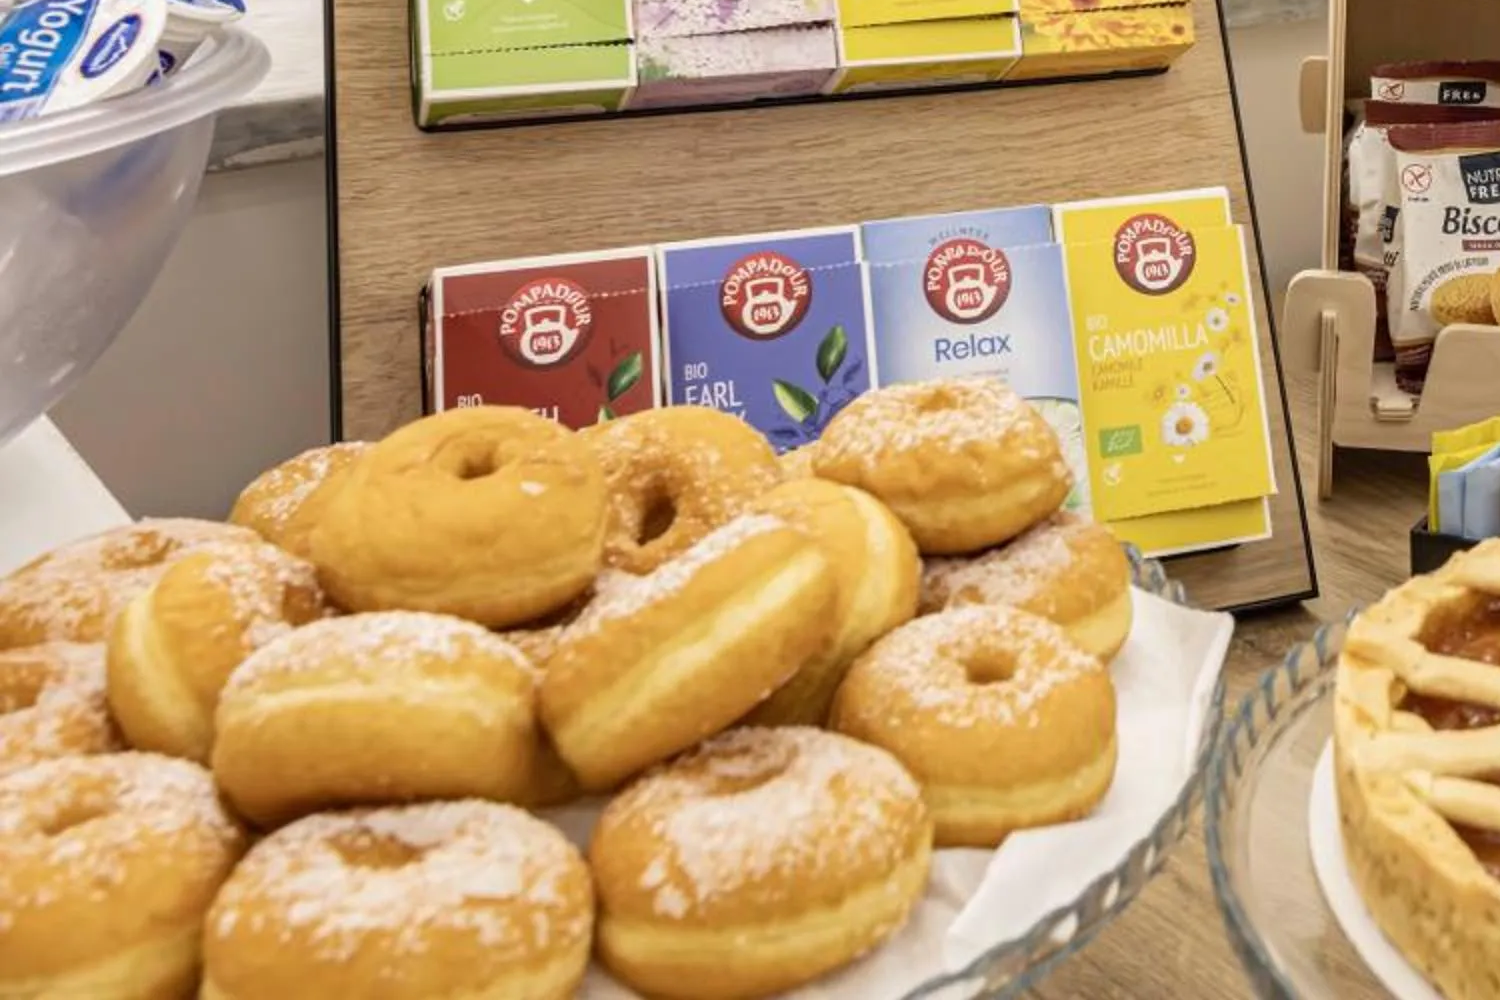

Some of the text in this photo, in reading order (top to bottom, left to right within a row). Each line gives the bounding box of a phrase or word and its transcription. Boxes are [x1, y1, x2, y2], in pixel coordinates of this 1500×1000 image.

[722, 256, 809, 307] POMPADOUR
[500, 283, 591, 336] POMPADOUR
[935, 333, 1012, 363] Relax
[1089, 323, 1209, 361] CAMOMILLA
[684, 362, 708, 381] BIO
[457, 394, 482, 408] BIO
[685, 379, 743, 408] EARL
